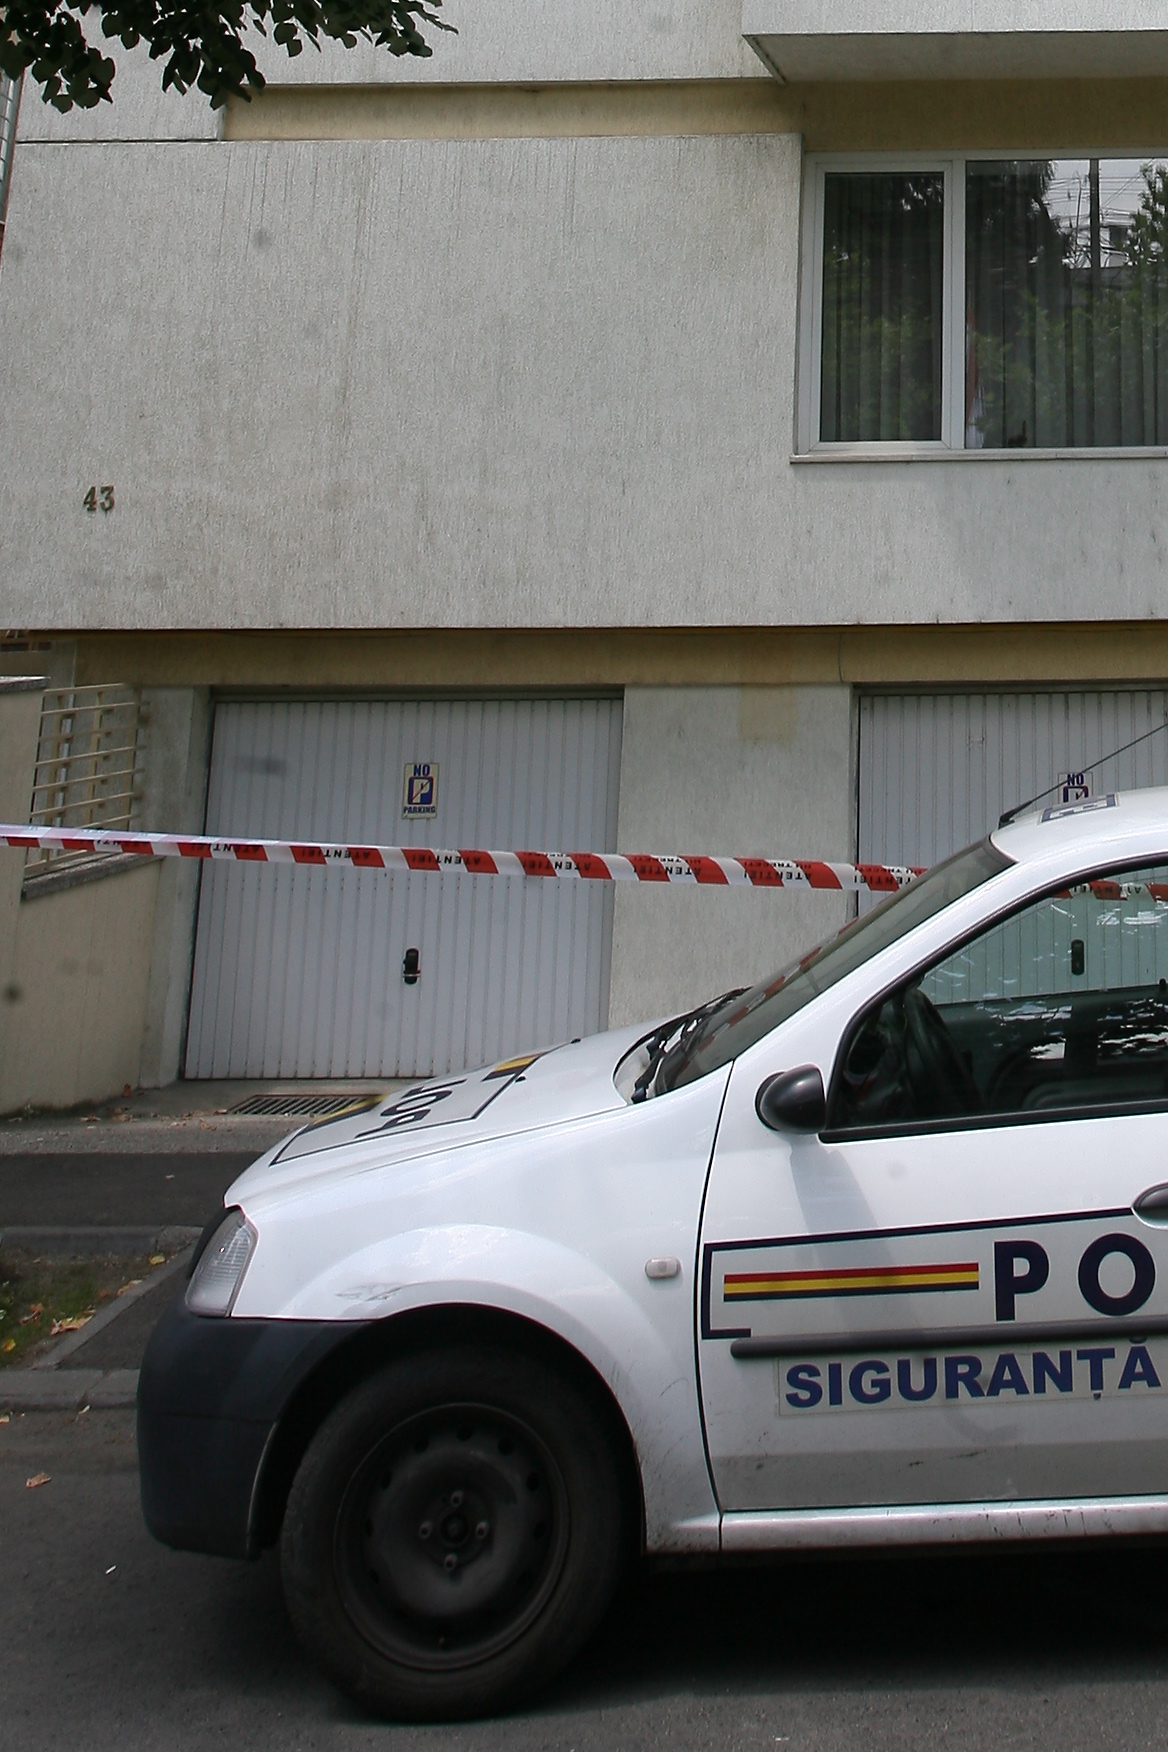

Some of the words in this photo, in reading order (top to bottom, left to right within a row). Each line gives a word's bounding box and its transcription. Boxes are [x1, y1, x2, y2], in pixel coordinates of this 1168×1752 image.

[83, 485, 115, 511] 43
[413, 764, 430, 776] NO
[1067, 773, 1084, 786] NO
[854, 874, 912, 885] TENTIE!
